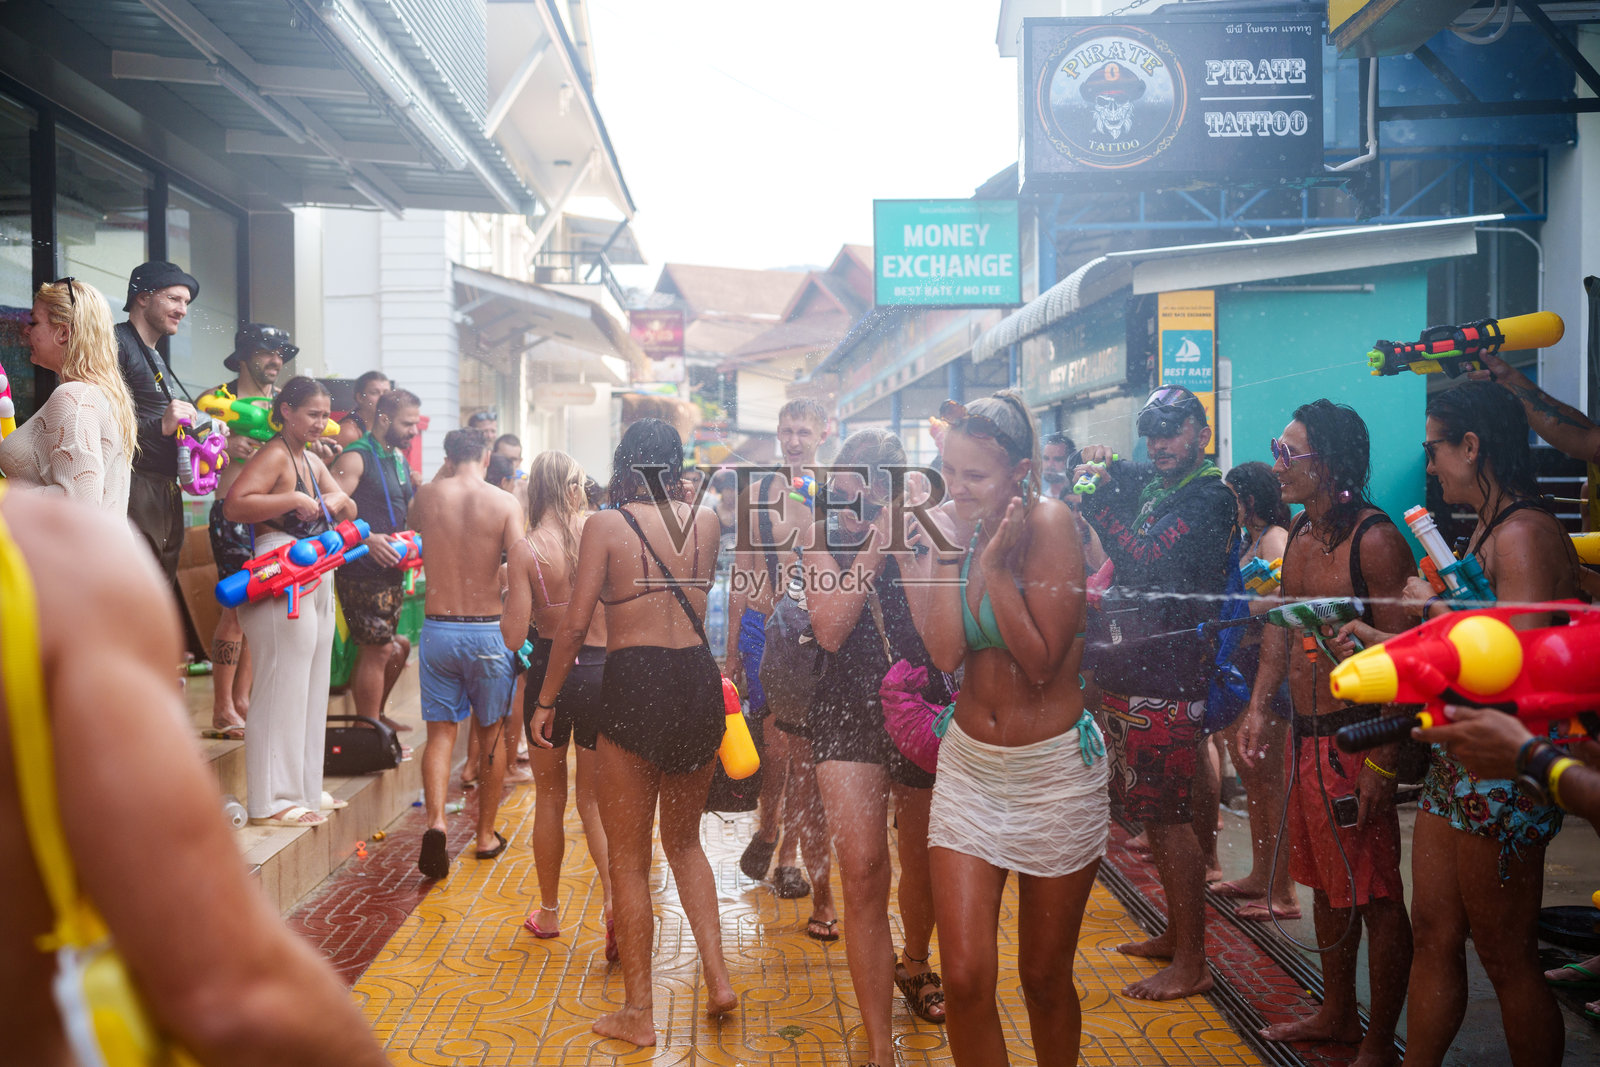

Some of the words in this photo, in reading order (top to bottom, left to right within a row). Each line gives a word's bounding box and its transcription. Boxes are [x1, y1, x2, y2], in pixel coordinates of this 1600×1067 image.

[1061, 41, 1163, 80] PIRATE
[1205, 58, 1306, 85] PIRATE
[1204, 110, 1308, 137] TATTOO
[1088, 138, 1140, 152] TATTOO
[903, 224, 990, 247] MONEY
[882, 253, 1013, 278] EXCHANGE
[894, 286, 921, 297] BEST
[924, 286, 953, 296] RATE
[963, 286, 980, 296] NO
[982, 285, 1001, 295] FEE
[1164, 368, 1186, 377] BEST
[1188, 368, 1212, 377] RATE
[1159, 517, 1190, 549] PHI
